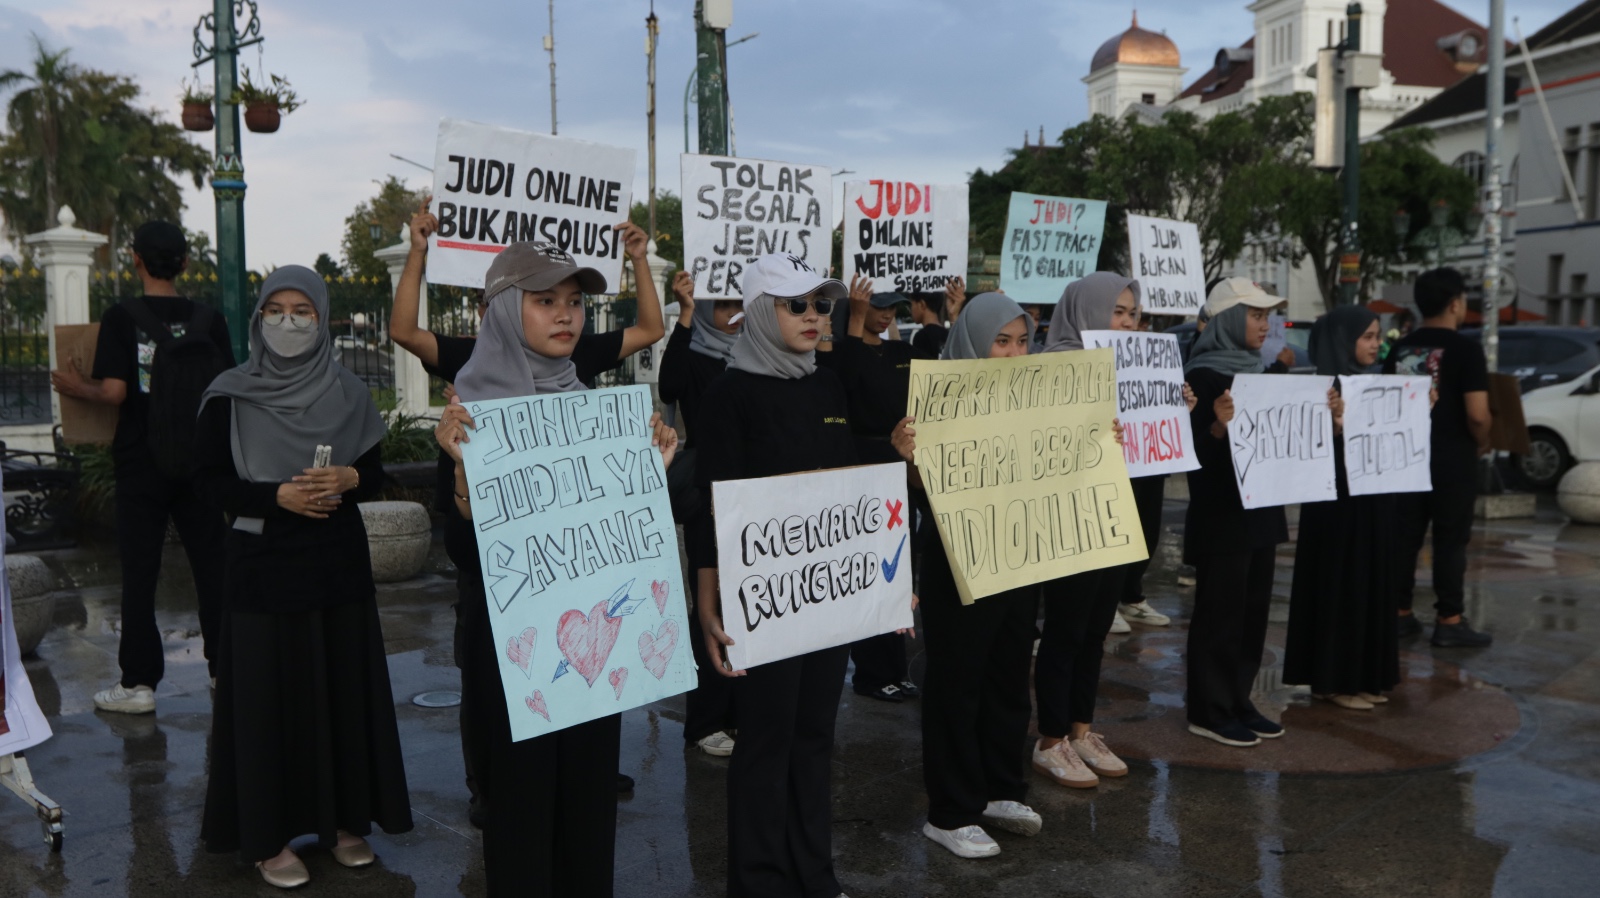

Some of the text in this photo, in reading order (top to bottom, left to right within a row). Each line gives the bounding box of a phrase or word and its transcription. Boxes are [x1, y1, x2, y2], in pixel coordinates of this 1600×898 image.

[445, 154, 621, 213] JUDI ONLINE
[710, 161, 814, 196] TOLAK
[855, 179, 930, 219] JUDI
[697, 184, 821, 227] SEGALA
[858, 218, 933, 251] ONLINE
[1009, 228, 1096, 254] FAST TRACK
[1151, 224, 1182, 249] JUDI
[1012, 253, 1032, 280] TO
[1035, 257, 1086, 279] GALAU
[1139, 252, 1187, 277] BUKAN
[1146, 286, 1198, 309] HIBURAN
[909, 369, 1002, 425] NEGARA
[470, 391, 648, 466] JANGAN
[1142, 416, 1184, 465] PALSU
[602, 447, 664, 497] YA
[920, 422, 1103, 497] NEGARA BEBAS
[740, 494, 883, 567] MENANG
[1004, 482, 1130, 571] ONLINE
[486, 506, 664, 614] SAYANG
[738, 551, 880, 632] RUNGKAD
